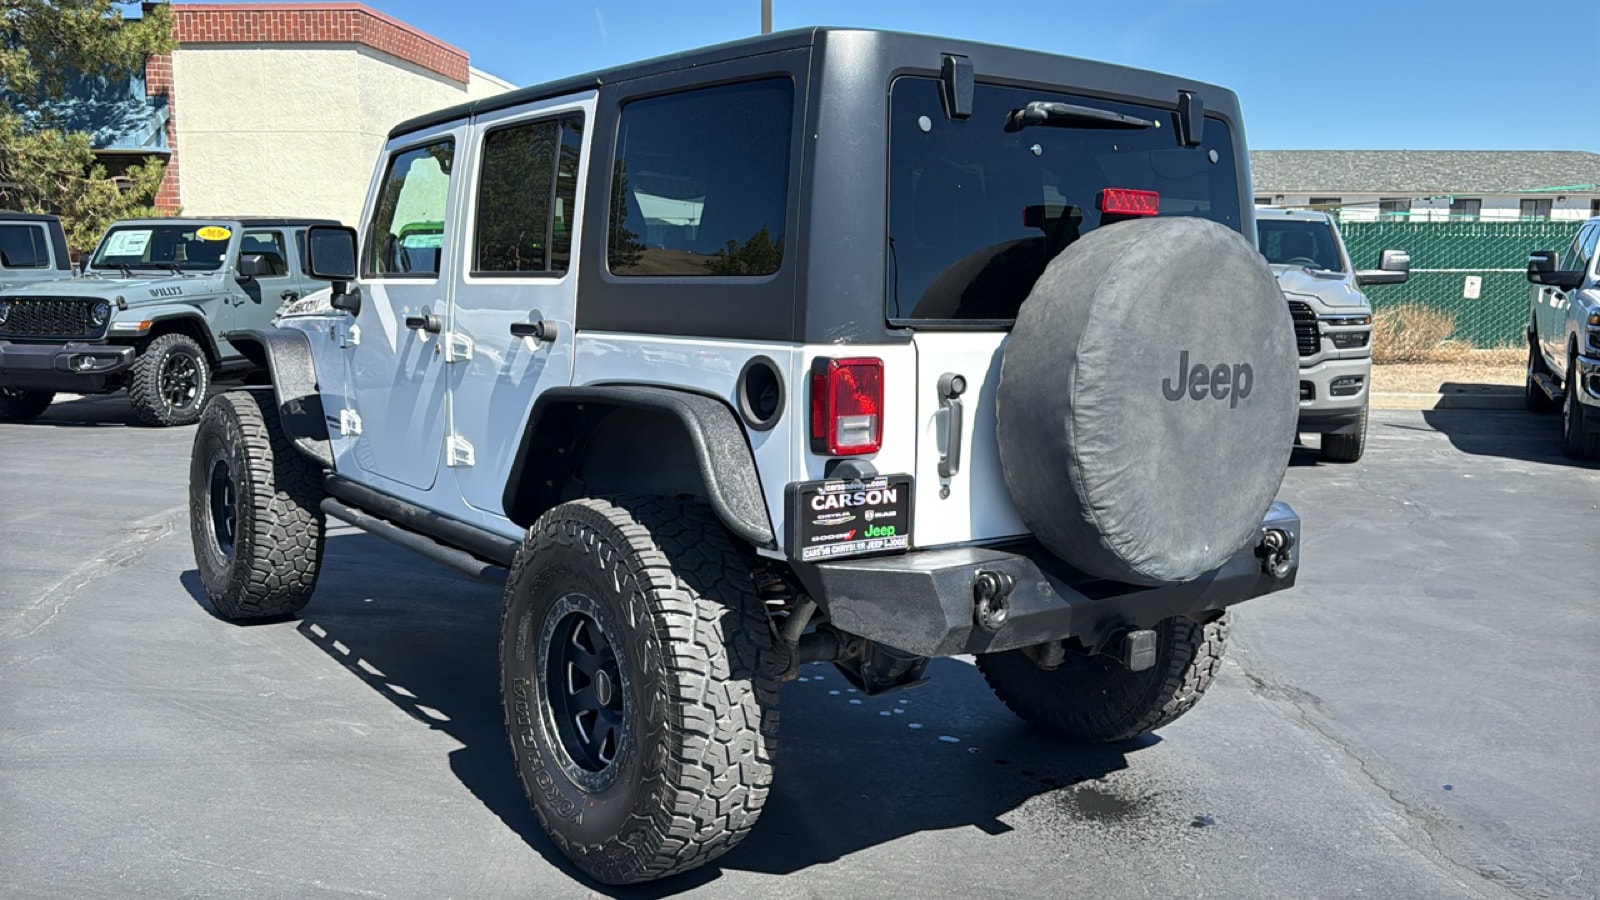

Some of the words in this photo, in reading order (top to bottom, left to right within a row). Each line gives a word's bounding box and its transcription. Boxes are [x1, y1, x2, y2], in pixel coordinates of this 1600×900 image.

[148, 286, 184, 297] WILLYS
[1162, 350, 1254, 409] Jeep
[811, 489, 897, 510] CARSON
[864, 524, 896, 538] Jeep
[513, 677, 584, 825] YOKOHAMA
